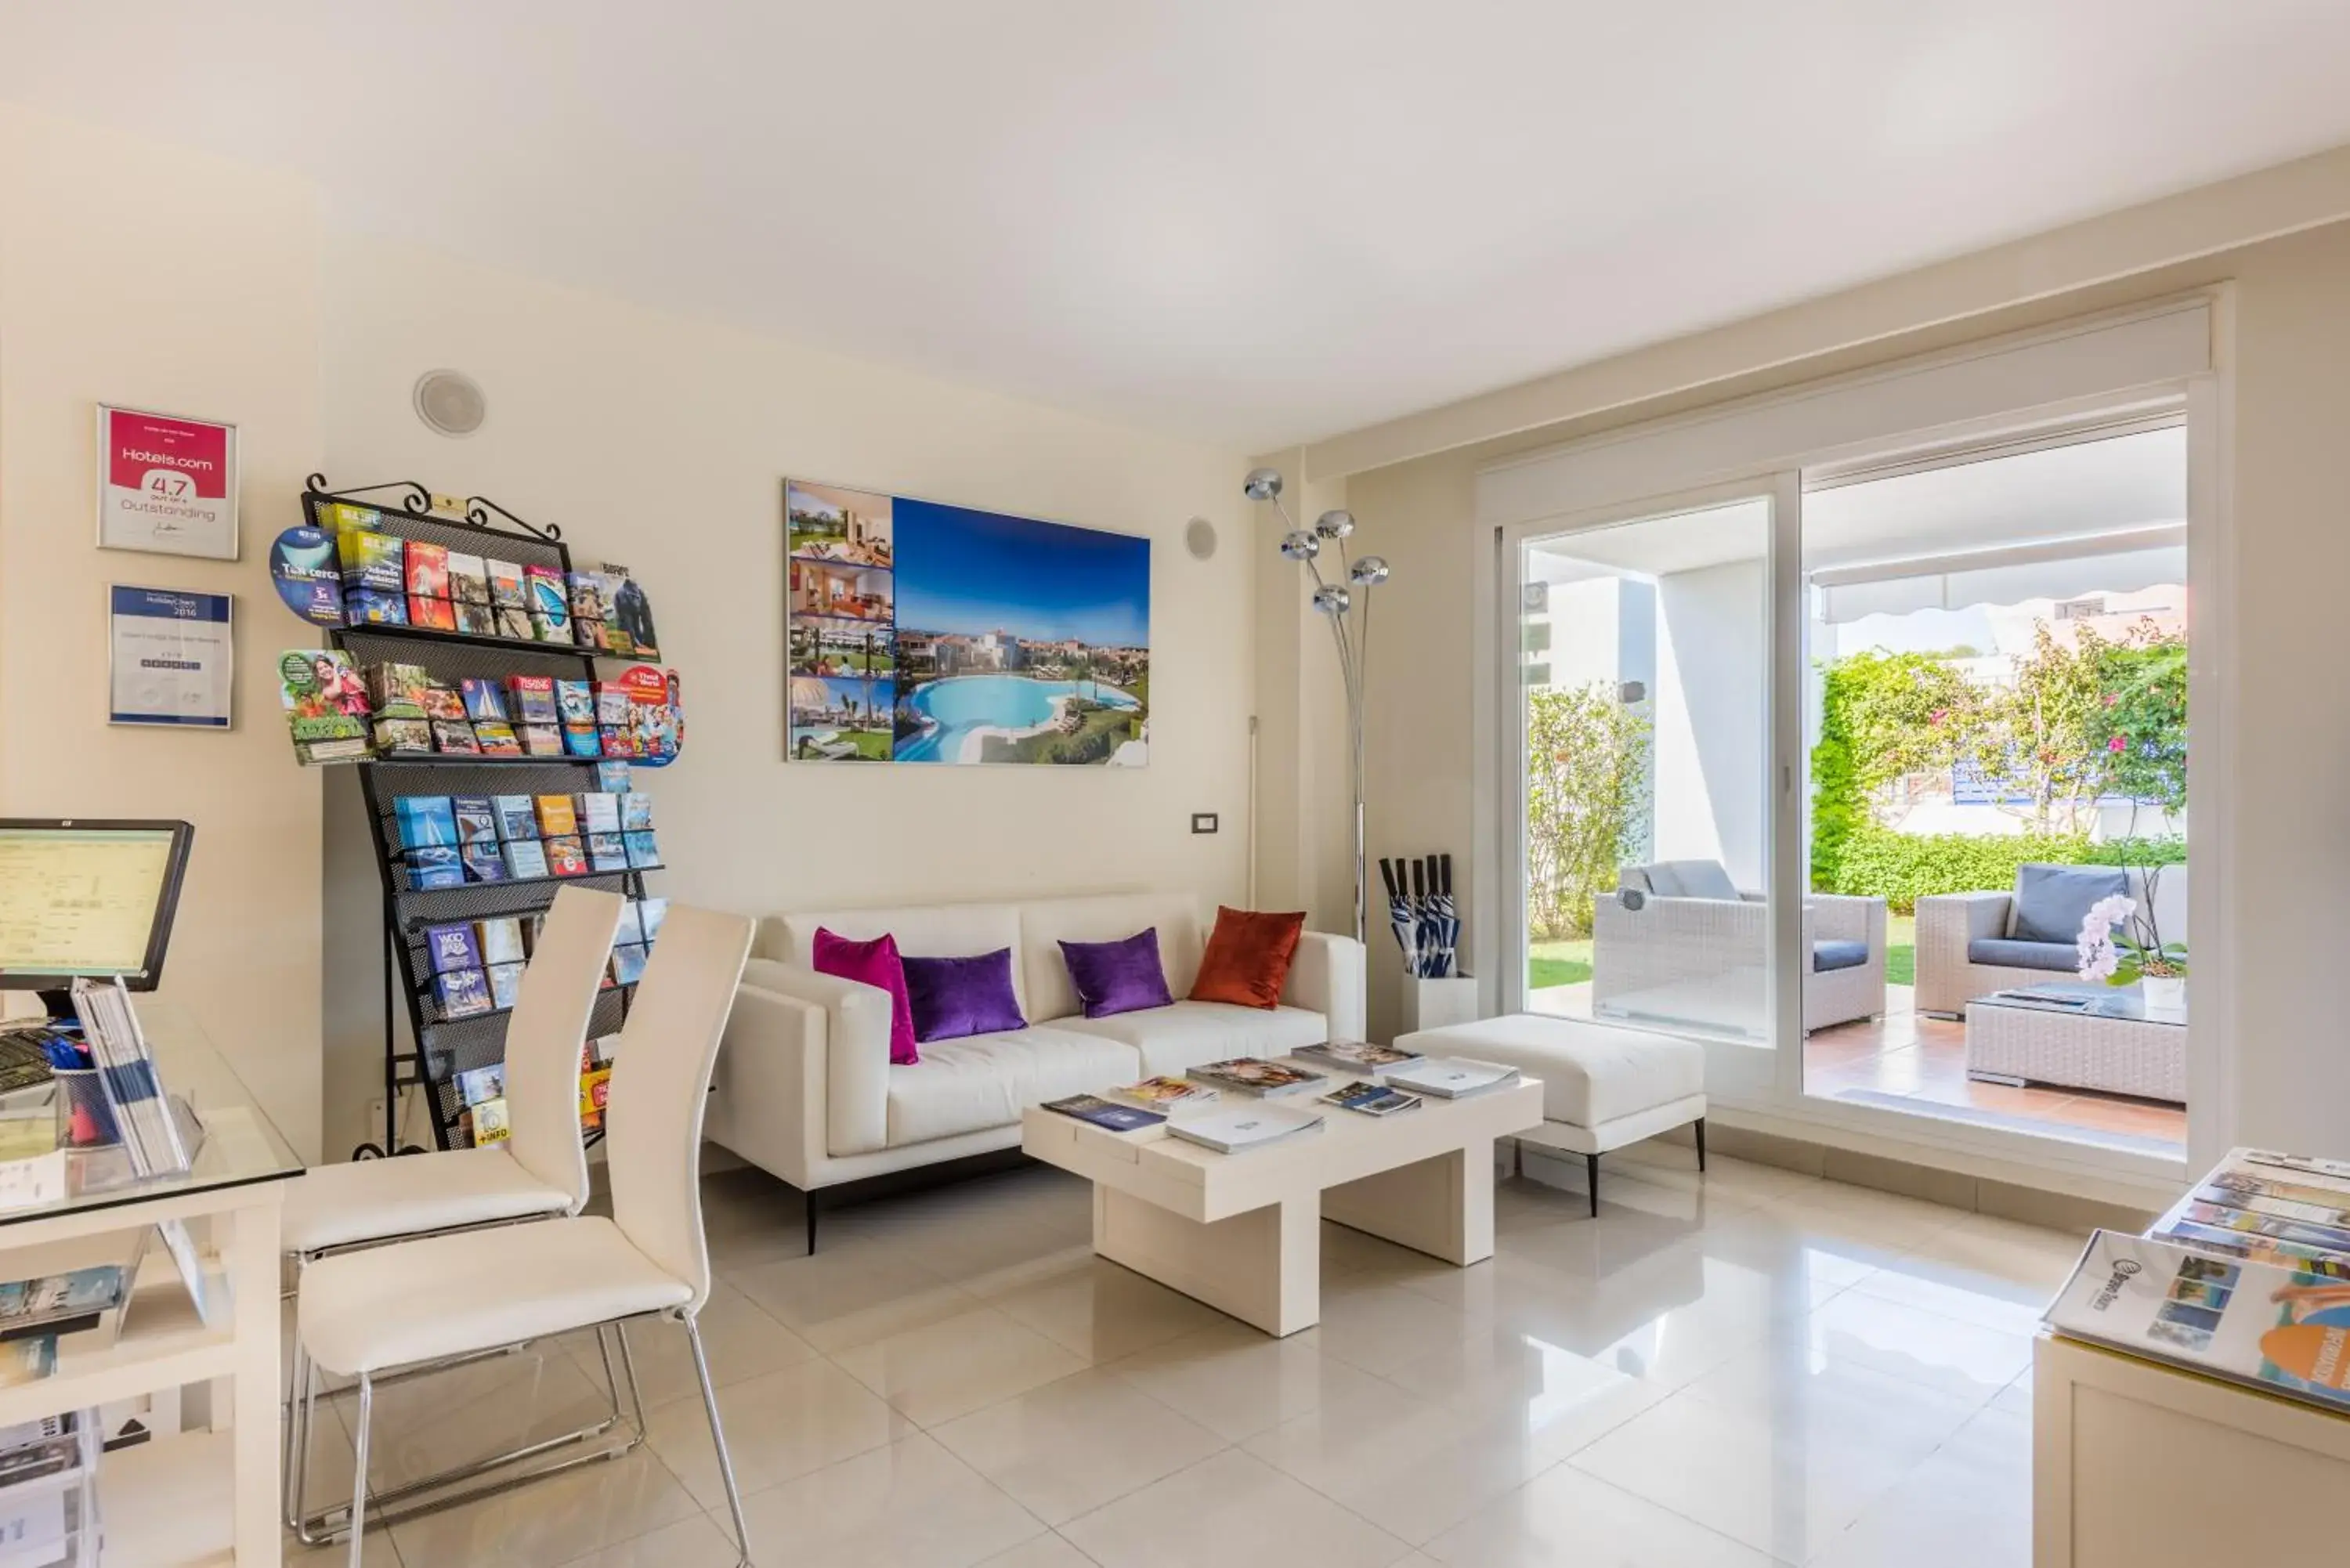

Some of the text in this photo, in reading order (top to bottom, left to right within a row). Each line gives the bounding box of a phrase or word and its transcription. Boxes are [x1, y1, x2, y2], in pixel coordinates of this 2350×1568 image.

[122, 447, 212, 471] Hotels.com
[151, 477, 188, 496] 4.7
[121, 498, 215, 522] Outstanding
